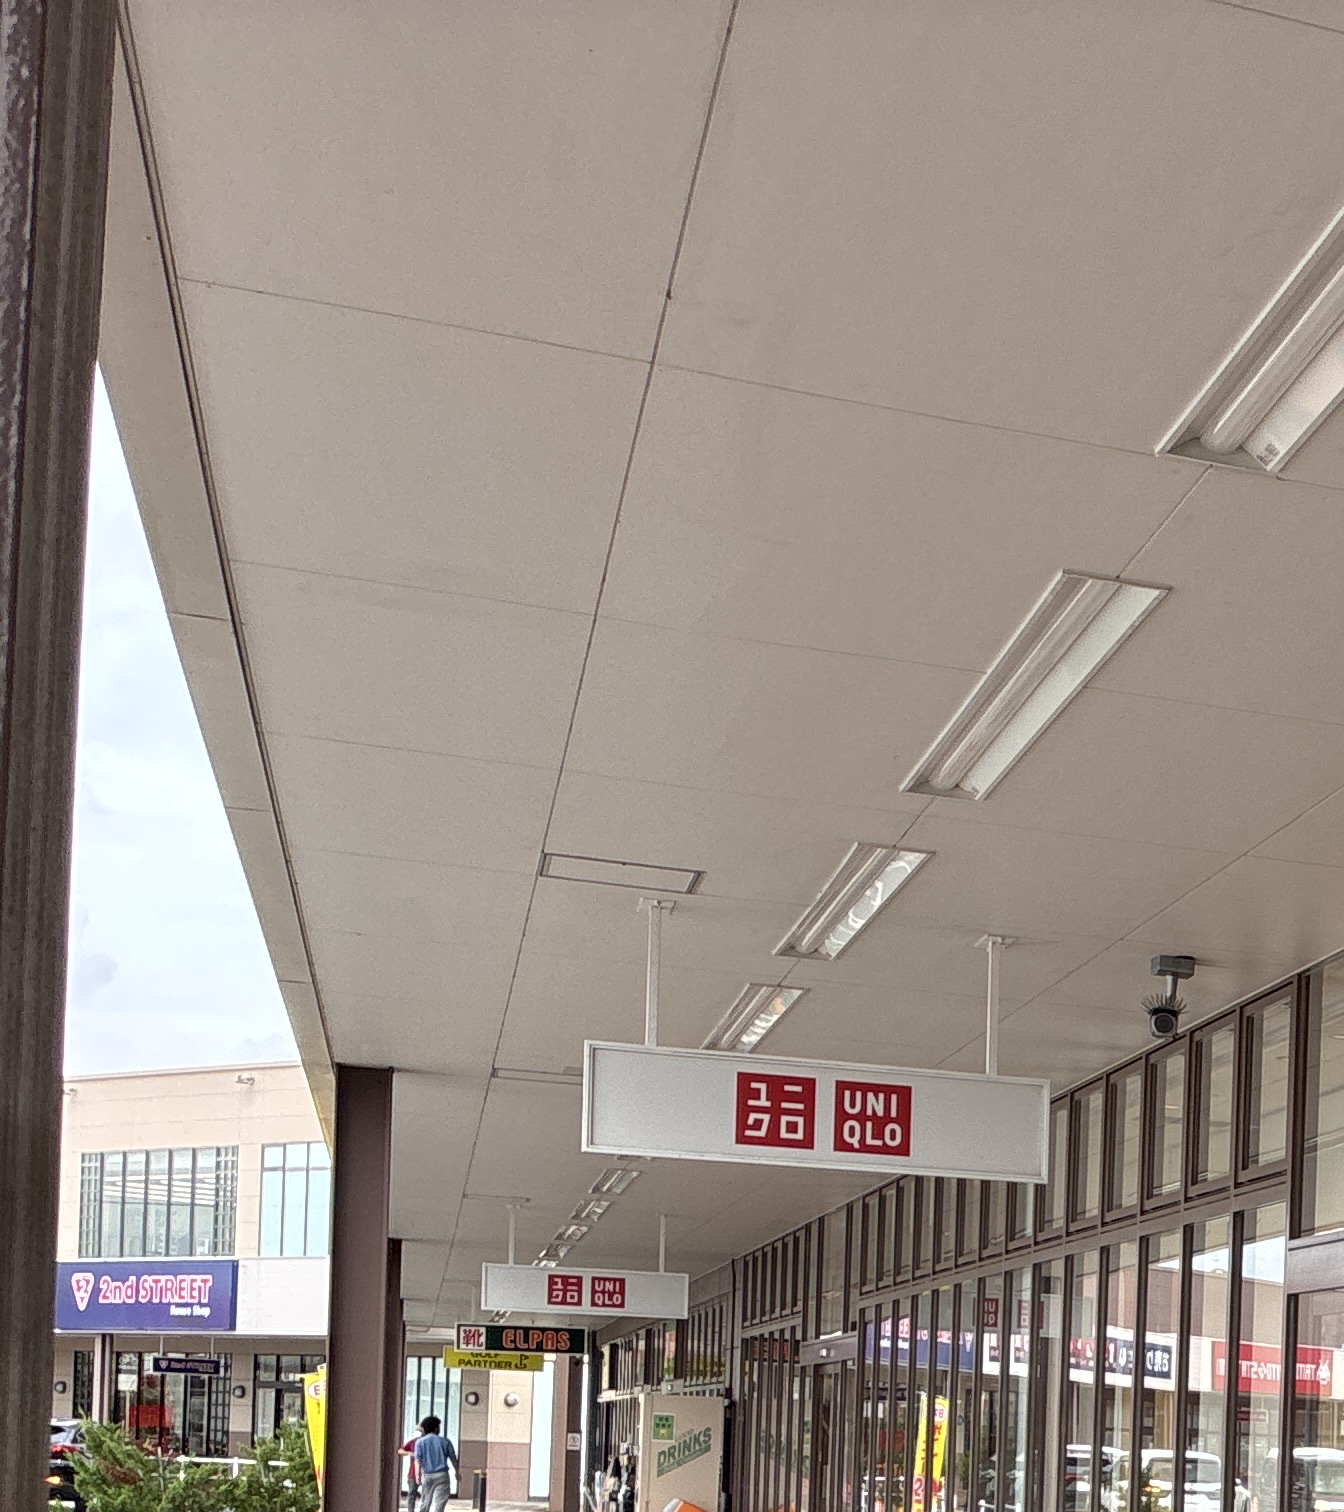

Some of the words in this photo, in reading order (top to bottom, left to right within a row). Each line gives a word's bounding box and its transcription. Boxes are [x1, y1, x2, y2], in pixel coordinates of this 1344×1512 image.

[99, 1275, 136, 1303] 2nd
[138, 1274, 213, 1304] STREET
[462, 1328, 483, 1348] 靴
[502, 1328, 571, 1350] ELPAS
[457, 1358, 513, 1369] PARTNER
[657, 1426, 712, 1471] DRINKS
